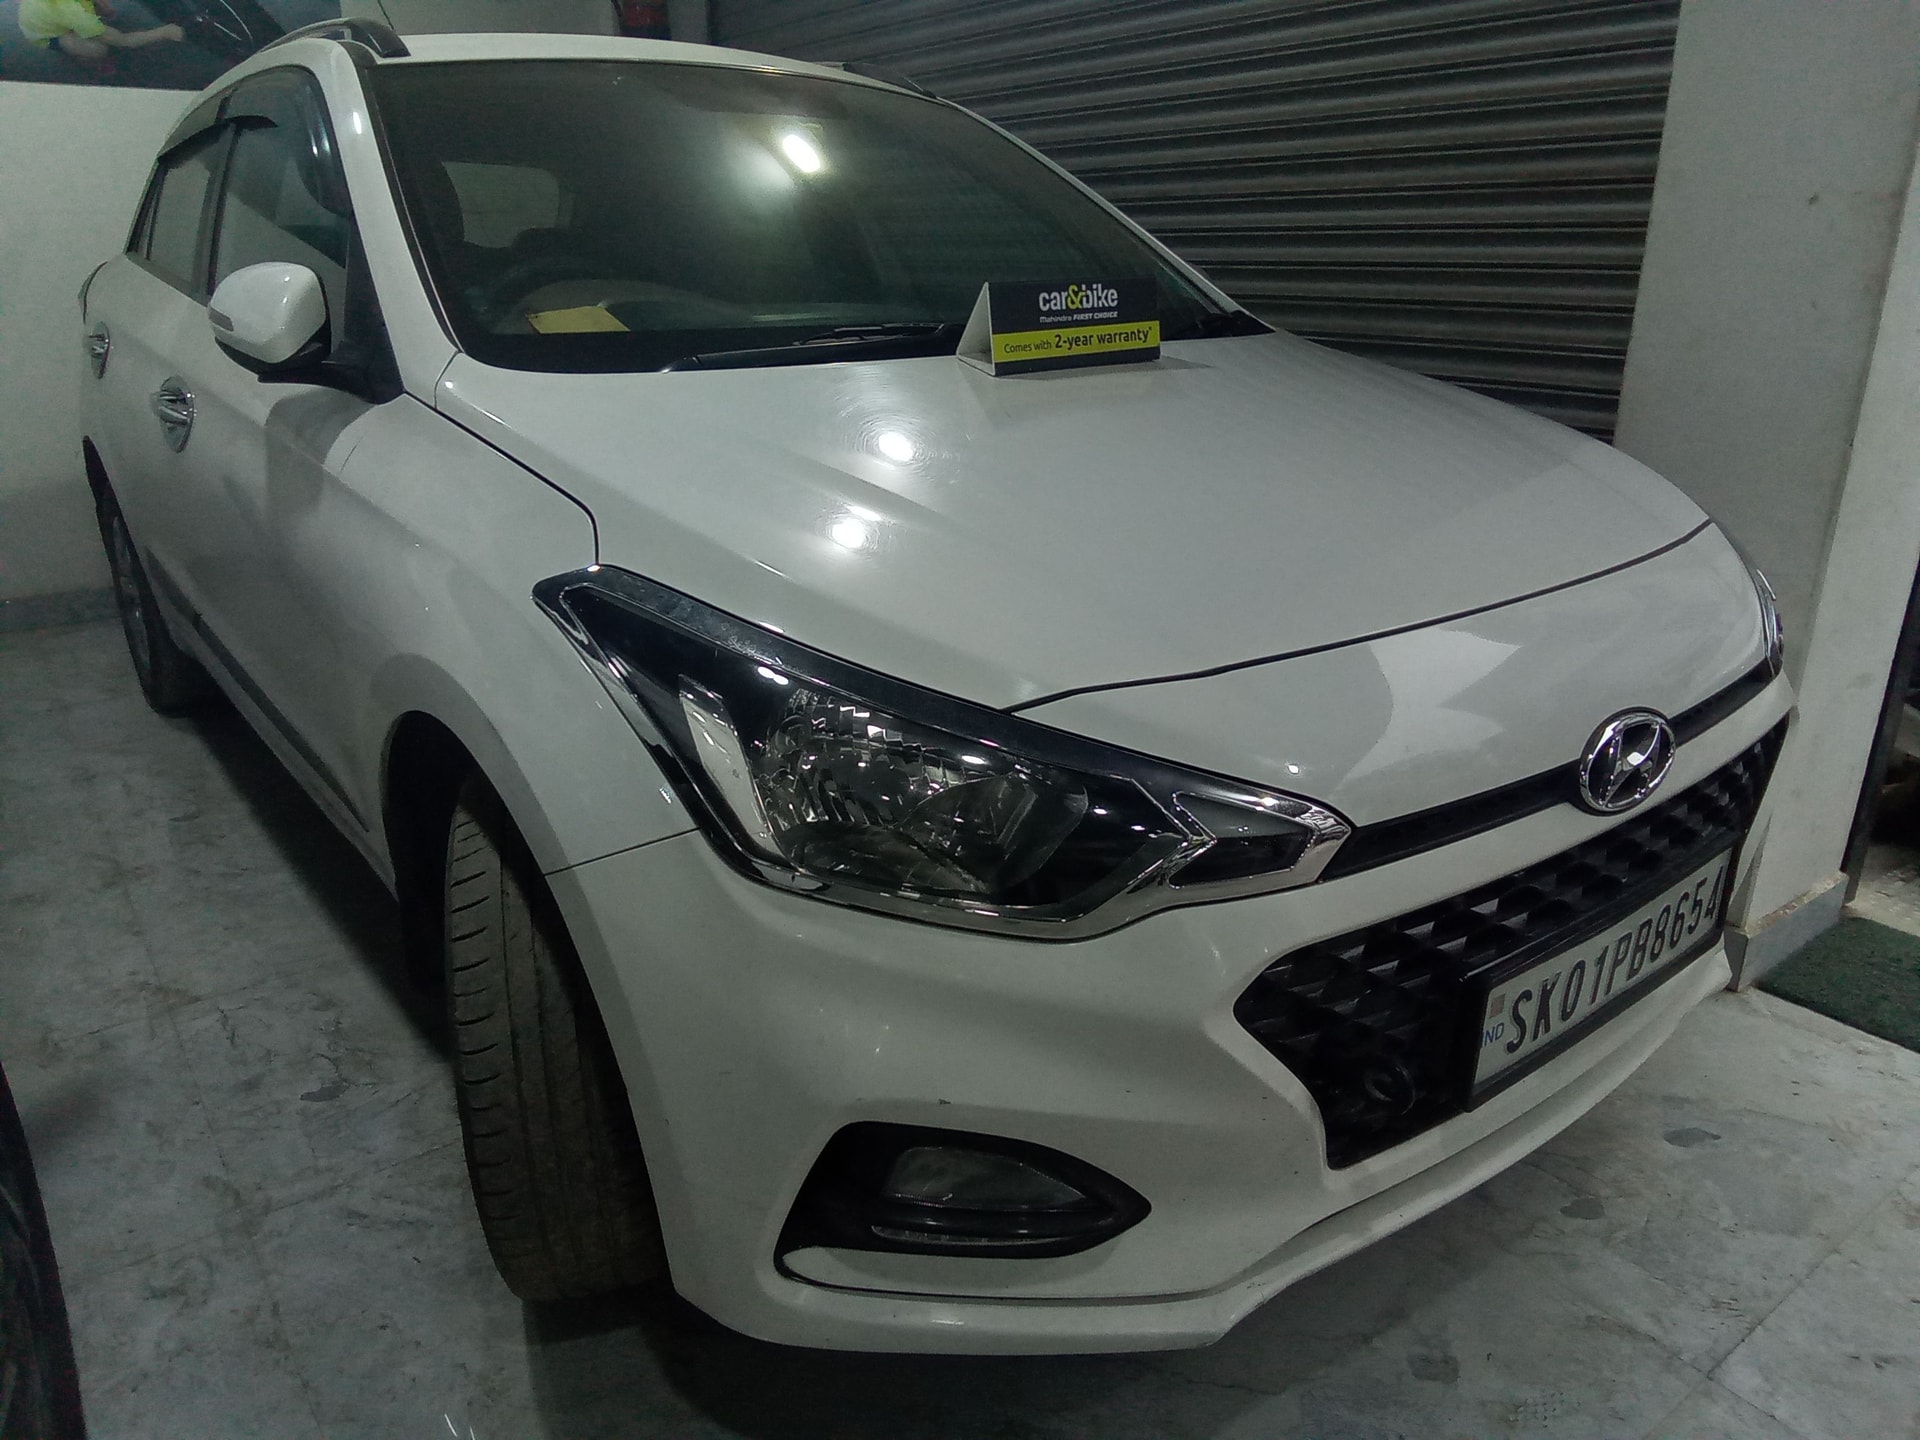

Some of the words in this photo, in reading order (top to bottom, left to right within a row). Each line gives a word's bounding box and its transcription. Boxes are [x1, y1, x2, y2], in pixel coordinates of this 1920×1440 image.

[1038, 284, 1118, 311] car&bike
[1094, 311, 1118, 319] CHOICE
[1004, 342, 1032, 354] Comes
[1033, 340, 1051, 351] with
[1054, 334, 1093, 350] 2-year
[1506, 865, 1724, 1053] SK01PB8654
